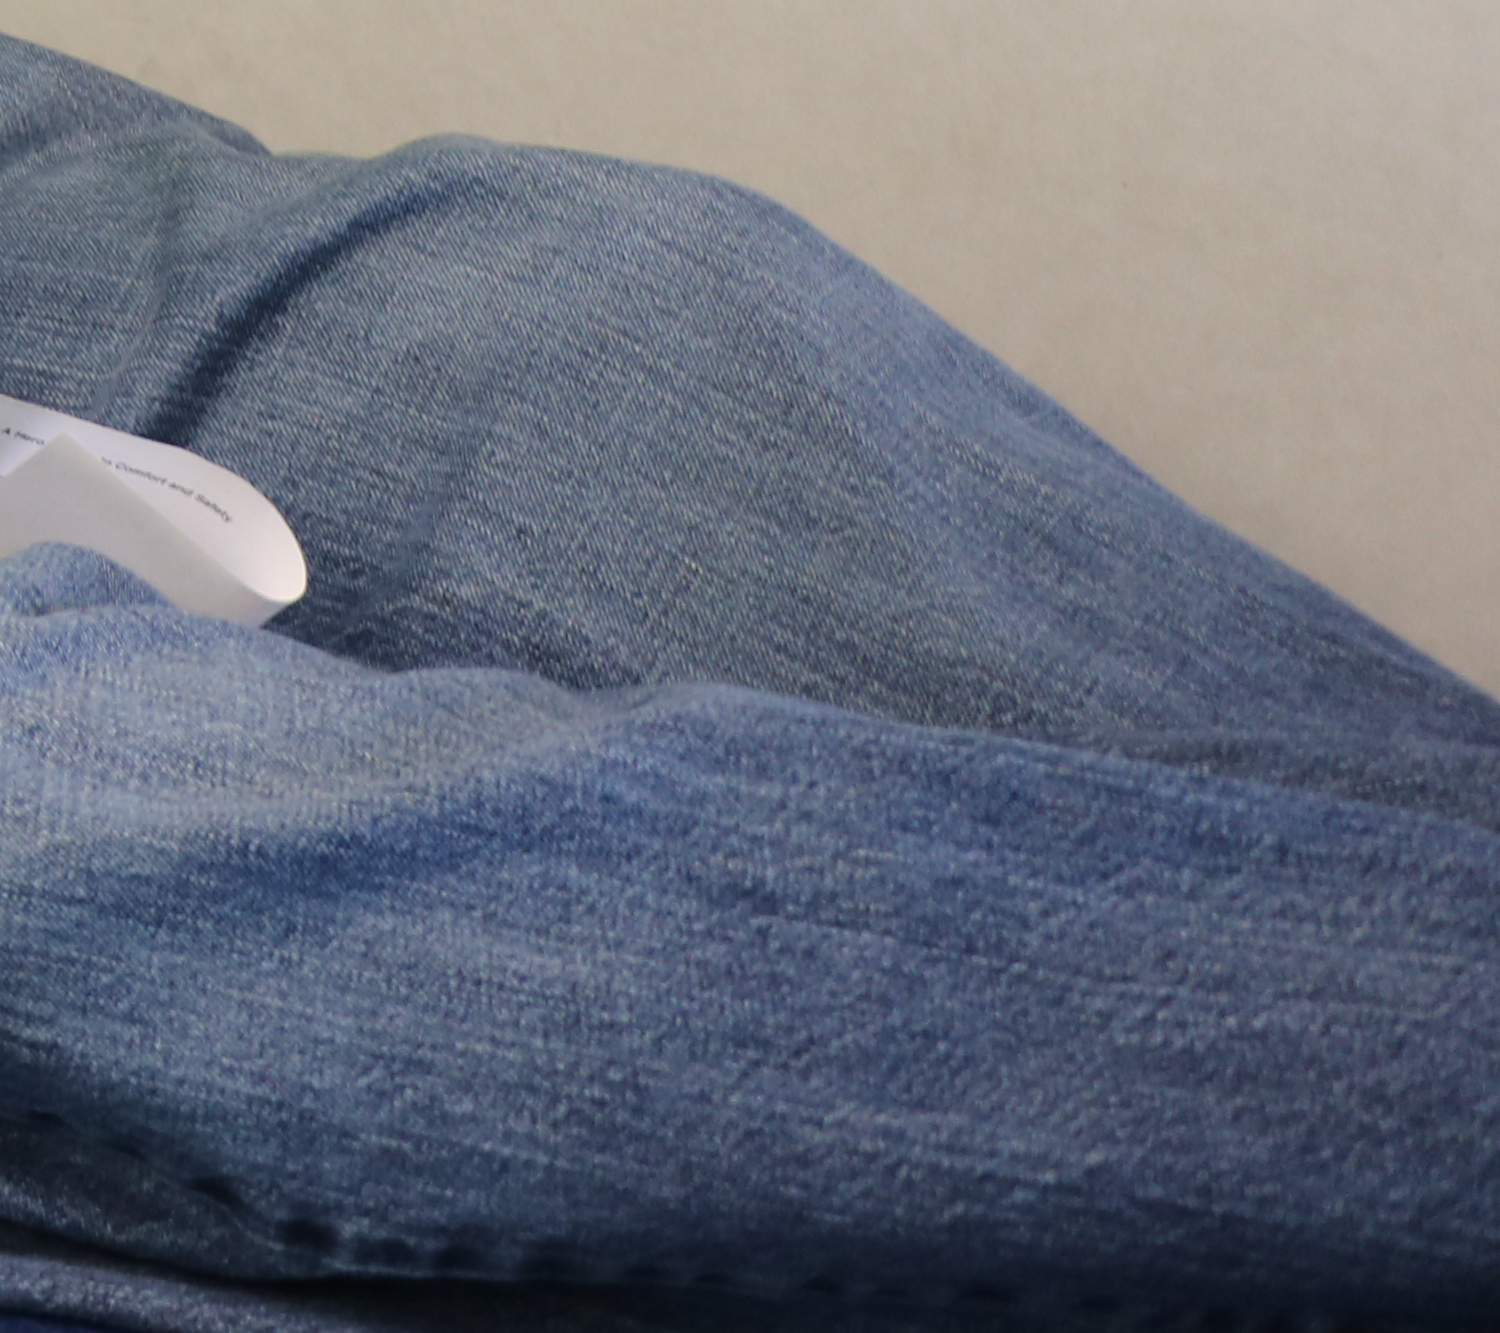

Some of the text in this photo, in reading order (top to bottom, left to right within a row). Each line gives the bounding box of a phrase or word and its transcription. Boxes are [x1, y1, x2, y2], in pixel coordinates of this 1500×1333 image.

[115, 461, 167, 485] Comfort
[168, 481, 193, 497] and
[195, 493, 232, 523] Safety
